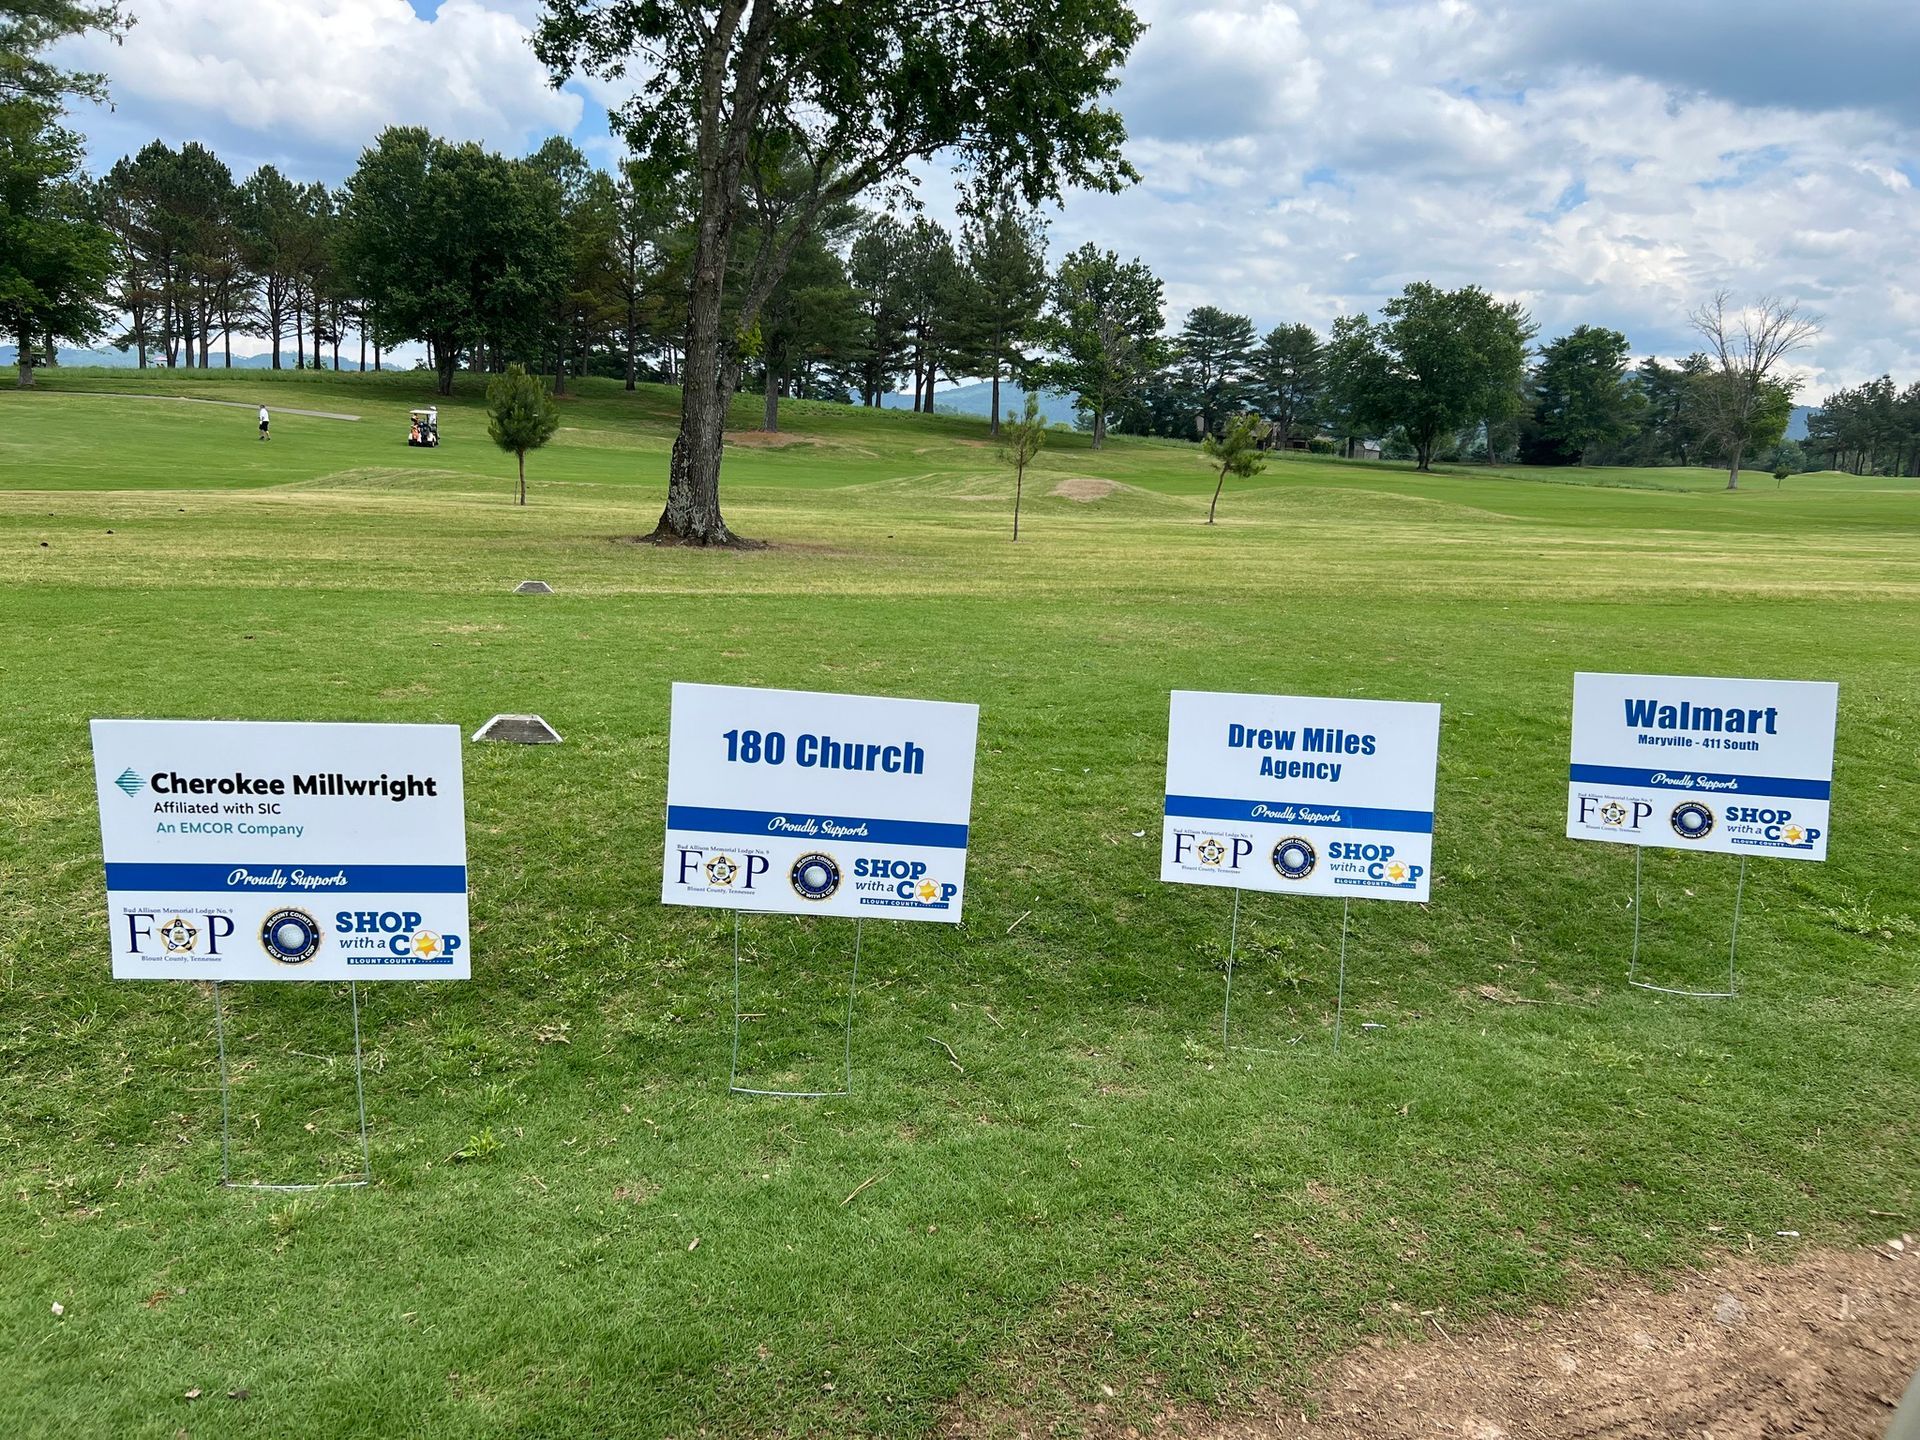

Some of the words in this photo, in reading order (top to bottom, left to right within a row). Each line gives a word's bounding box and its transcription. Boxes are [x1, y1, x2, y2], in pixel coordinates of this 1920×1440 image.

[1624, 698, 1778, 735] Walmart
[1228, 723, 1296, 751] Drew
[1302, 727, 1376, 755] Miles
[1638, 734, 1693, 747] Maryville
[1702, 738, 1721, 749] 411
[1724, 739, 1759, 751] South
[723, 729, 786, 765] 180
[796, 734, 925, 775] Church
[1260, 756, 1342, 782] Agency
[151, 772, 285, 795] Cherokee
[293, 774, 437, 801] Millwright
[1651, 773, 1694, 789] Proudly
[1696, 776, 1738, 790] Supports
[153, 802, 219, 814] Affiliated
[223, 803, 253, 815] with
[258, 803, 281, 815] SIC
[1251, 804, 1296, 822] Proudly
[1298, 808, 1341, 823] Supports
[1725, 807, 1791, 825] SHOP
[156, 823, 176, 834] An
[181, 823, 233, 834] EMCOR
[238, 823, 303, 837] Company
[768, 816, 819, 836] Proudly
[820, 820, 869, 837] Supports
[1727, 825, 1753, 834] with
[1328, 842, 1395, 861] SHOP
[854, 858, 927, 880] SHOP
[1330, 862, 1356, 872] with
[227, 868, 288, 888] Proudly
[290, 870, 348, 888] Supports
[855, 881, 884, 891] with
[887, 884, 894, 892] a
[267, 912, 289, 927] BLOUNT
[290, 912, 314, 926] COUNTY
[336, 911, 421, 933] SHOP
[340, 937, 374, 949] with
[377, 939, 385, 948] a
